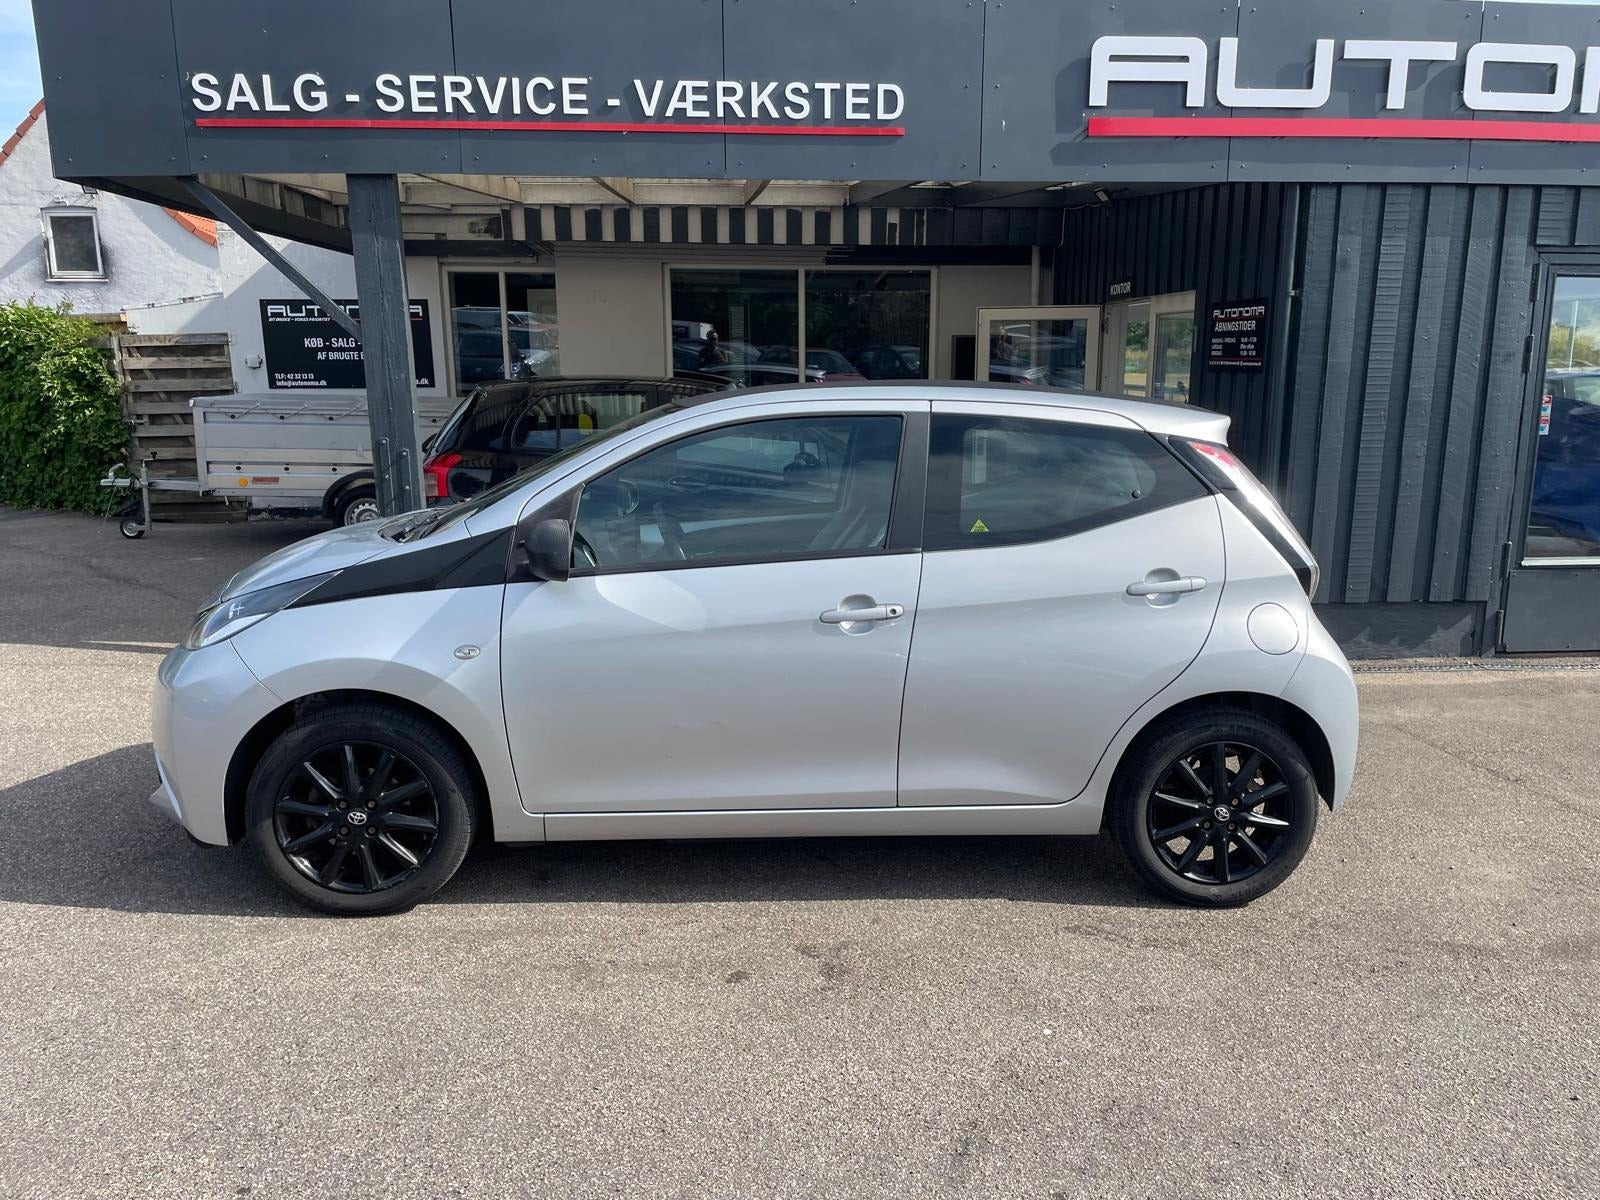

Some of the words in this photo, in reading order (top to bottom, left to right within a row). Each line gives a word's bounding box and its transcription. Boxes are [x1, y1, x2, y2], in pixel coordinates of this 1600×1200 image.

[1089, 36, 1600, 113] AUTO
[191, 72, 328, 112] SALG
[346, 94, 360, 103] -
[376, 74, 588, 115] SERVICE
[607, 98, 621, 106] -
[634, 79, 905, 121] VÆRKSTED
[1110, 281, 1131, 296] KONTOR
[1213, 305, 1265, 319] AUTONOMA
[1215, 320, 1256, 332] ÅBNINGSTIDER
[304, 337, 324, 348] KØB
[331, 337, 356, 348] SALG
[317, 351, 327, 361] AF
[328, 351, 359, 361] BRUGTE
